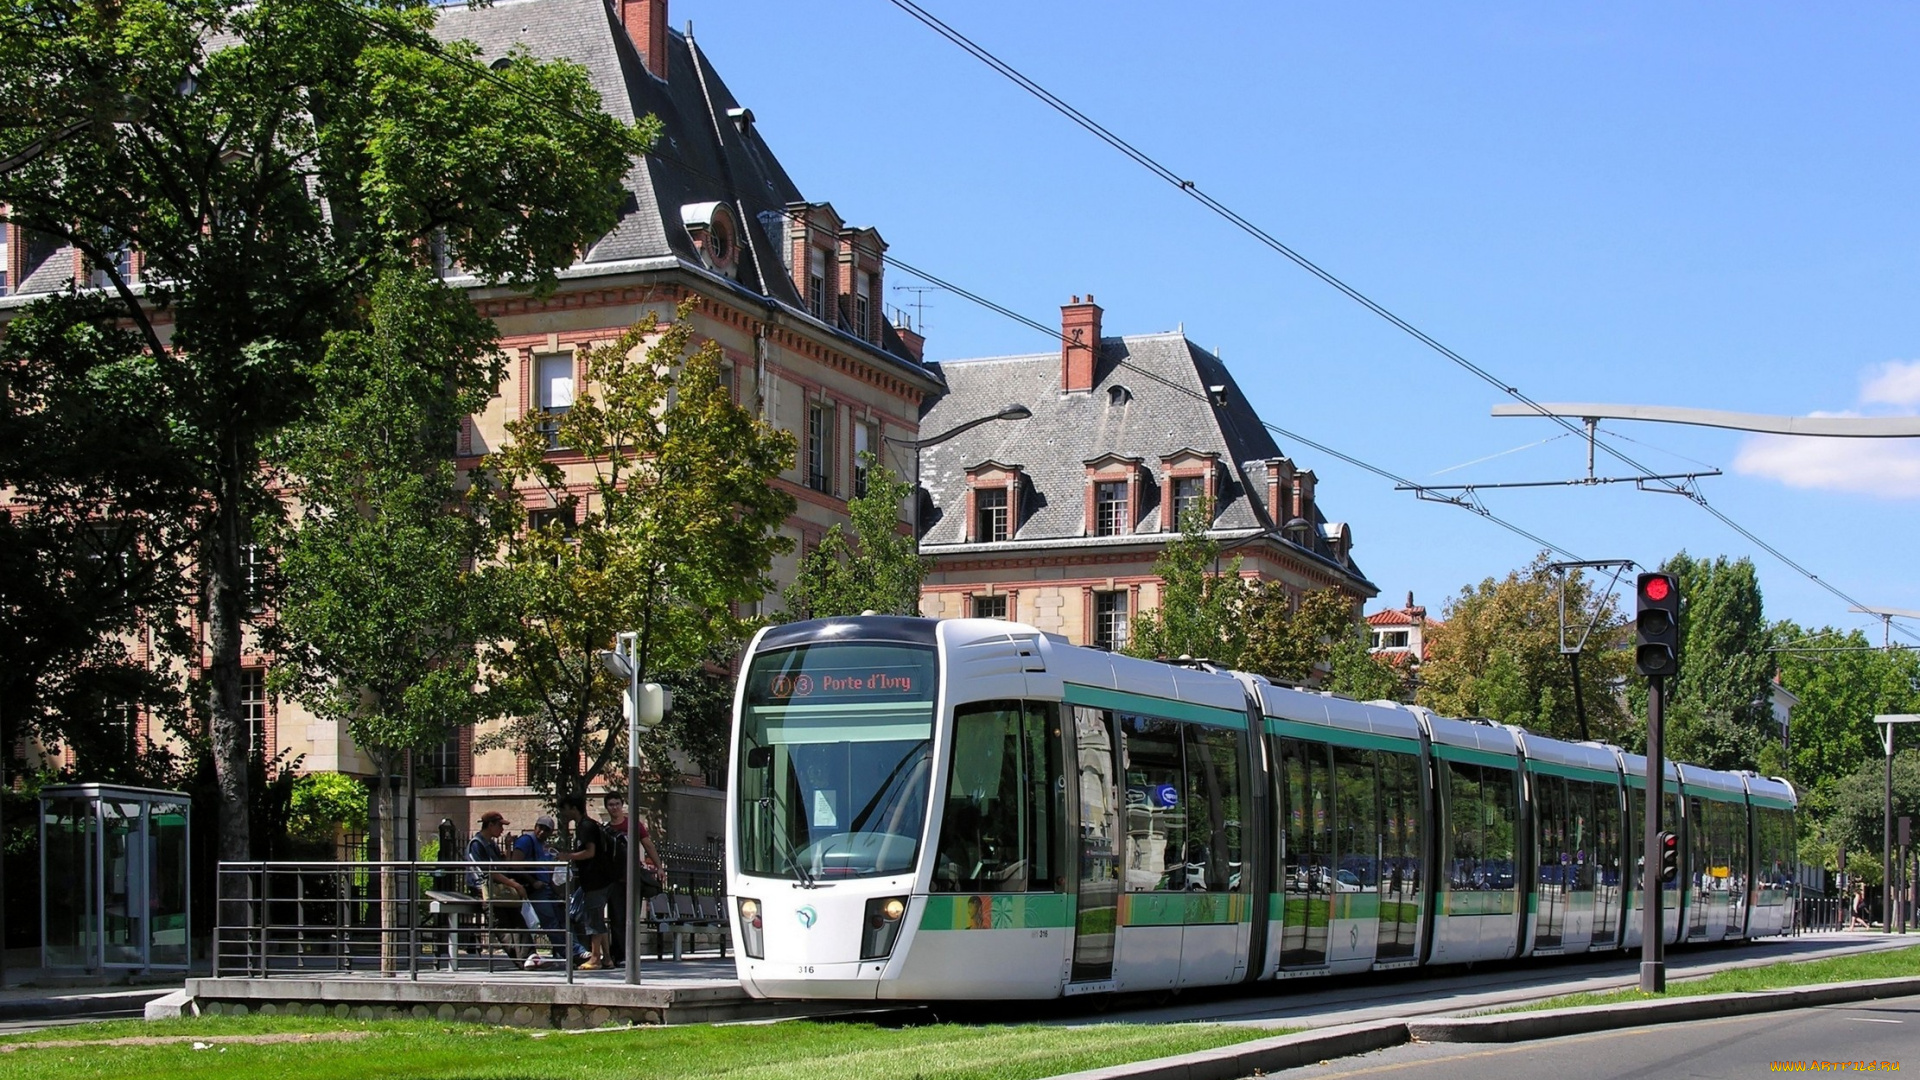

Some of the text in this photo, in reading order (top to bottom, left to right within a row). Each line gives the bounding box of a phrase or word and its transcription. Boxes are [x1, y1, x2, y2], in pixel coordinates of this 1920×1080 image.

[823, 675, 863, 691] Porte
[867, 673, 911, 692] d'Ivry
[798, 965, 815, 974] 316
